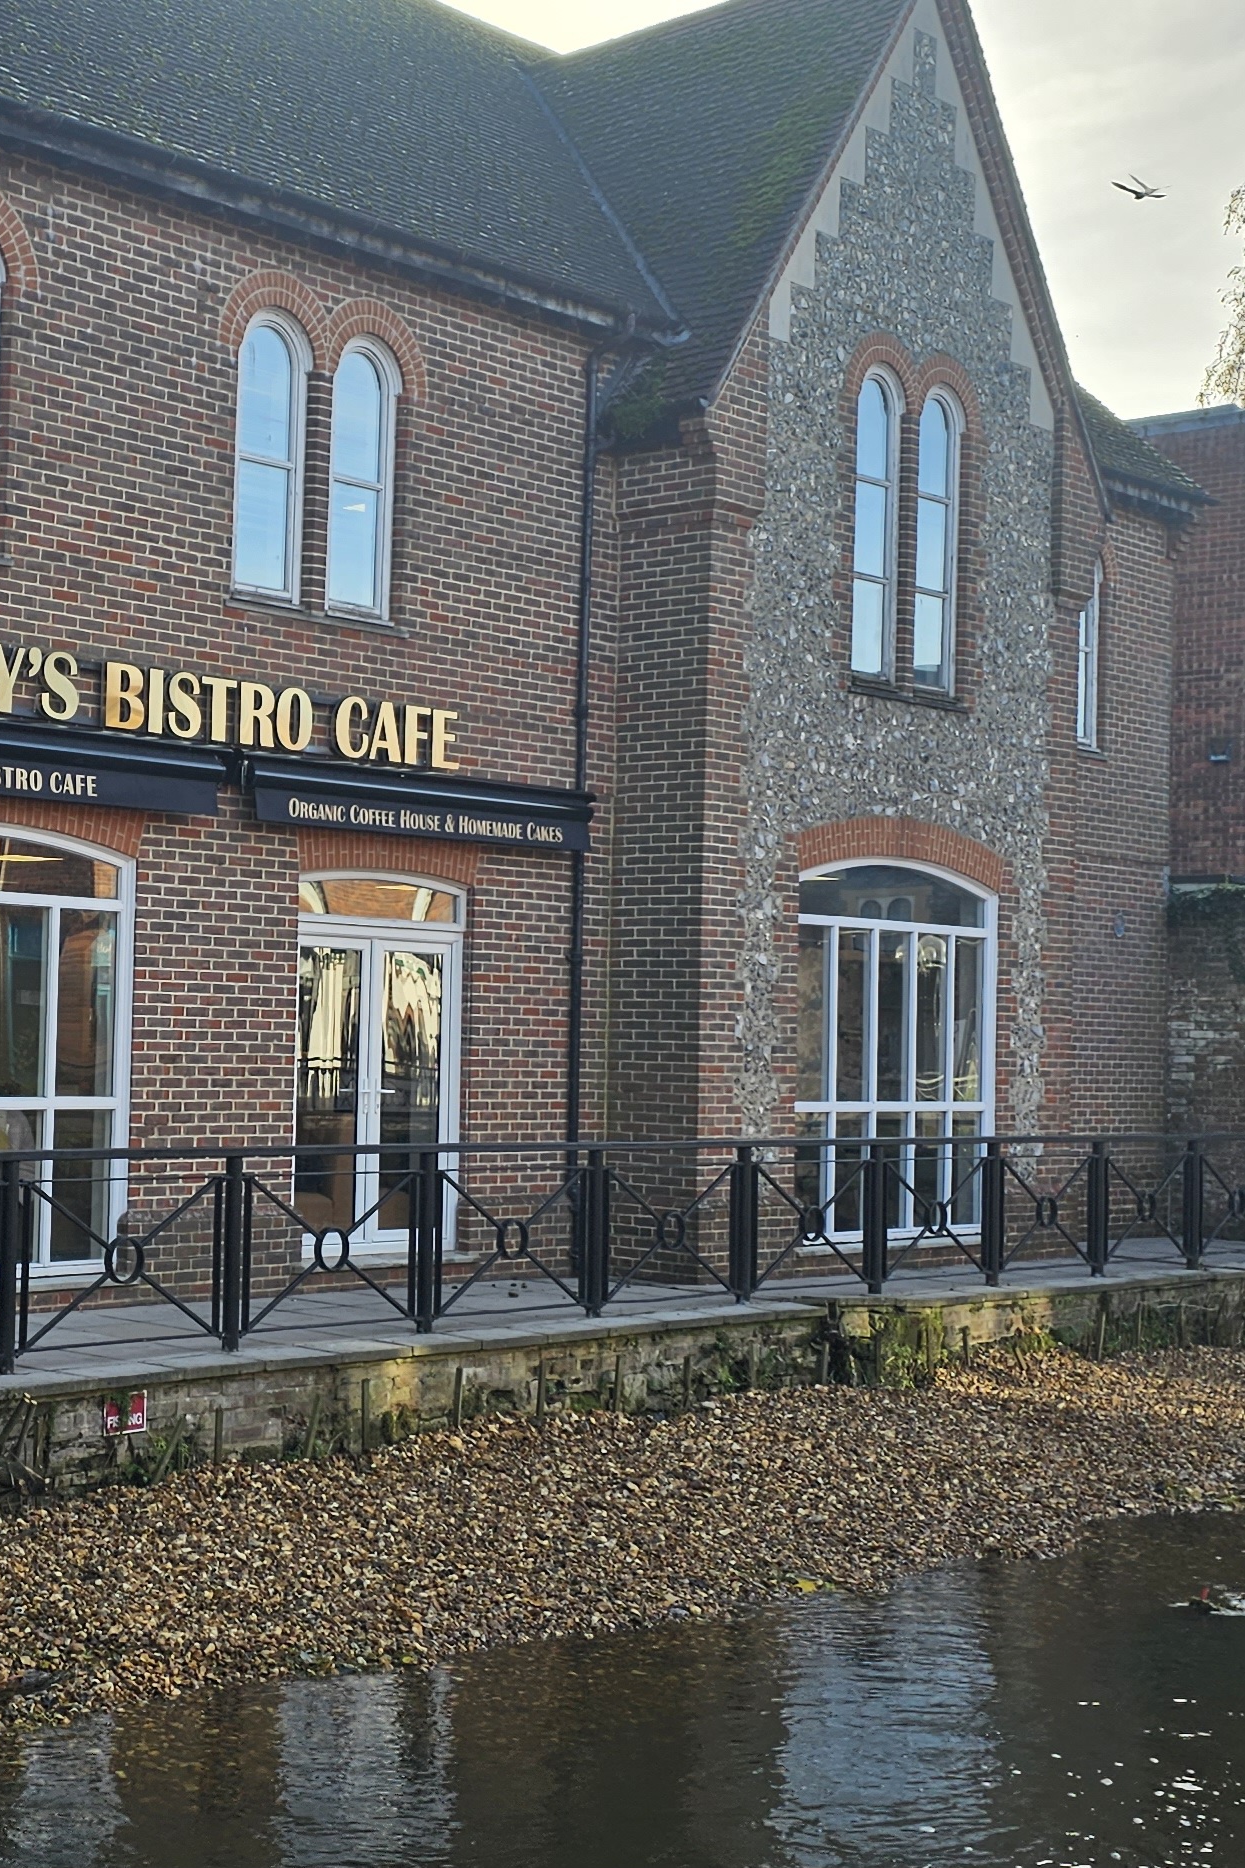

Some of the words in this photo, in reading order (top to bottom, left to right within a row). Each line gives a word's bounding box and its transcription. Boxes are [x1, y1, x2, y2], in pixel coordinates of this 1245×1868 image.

[105, 661, 312, 751] BISTRO
[335, 696, 459, 770] CAFE
[50, 772, 97, 797] CAFE
[288, 797, 346, 822] ORGANIC
[349, 805, 396, 828] COFFEE
[400, 810, 441, 832] HOUSE
[445, 814, 456, 832] &
[458, 816, 525, 840] HOMEMADE
[527, 822, 563, 843] CAKES
[107, 1412, 143, 1429] FISNG
